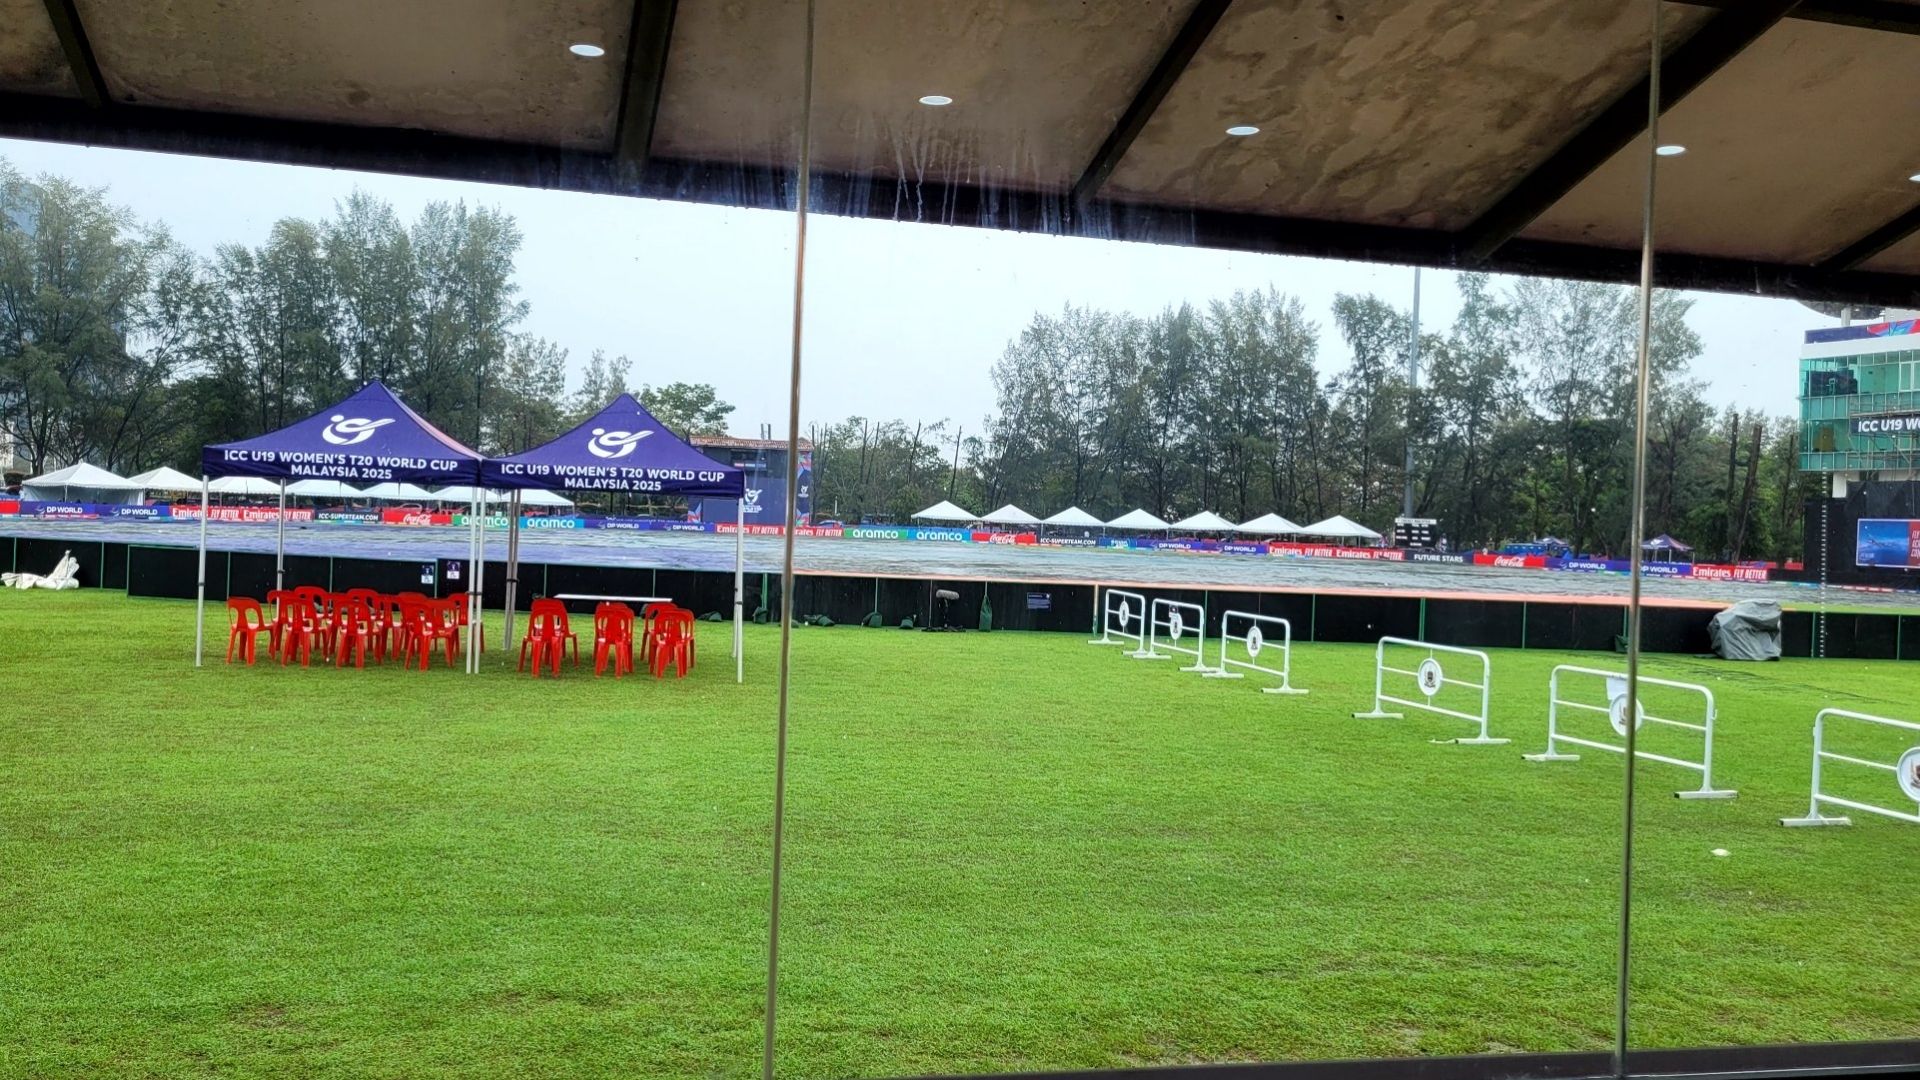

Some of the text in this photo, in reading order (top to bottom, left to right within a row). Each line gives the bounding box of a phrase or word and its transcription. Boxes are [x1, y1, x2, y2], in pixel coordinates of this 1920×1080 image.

[1858, 418, 1920, 432] ICC U19 W
[224, 450, 458, 471] ICC U19 WOMEN'S T20 WORLD CUP
[291, 464, 392, 479] MALAYSIA 2025
[501, 464, 725, 482] ICC U19 WOMEN'S T20 WORLD CUP
[565, 477, 661, 491] MALAYSIA 2025
[57, 506, 83, 514] WORLD
[172, 507, 208, 518] Emirate
[243, 509, 281, 520] Emirates
[318, 512, 379, 521] ICC-SUPERTEAM.COM
[527, 518, 575, 529] aramco
[853, 529, 898, 539] aramco
[916, 531, 963, 541] aramco
[1040, 537, 1096, 546] ICC-SUPERTEAM.COM
[1269, 546, 1303, 556] Emirates
[1336, 549, 1371, 559] Emirates
[1693, 566, 1767, 580] Emirates FLY BETTER
